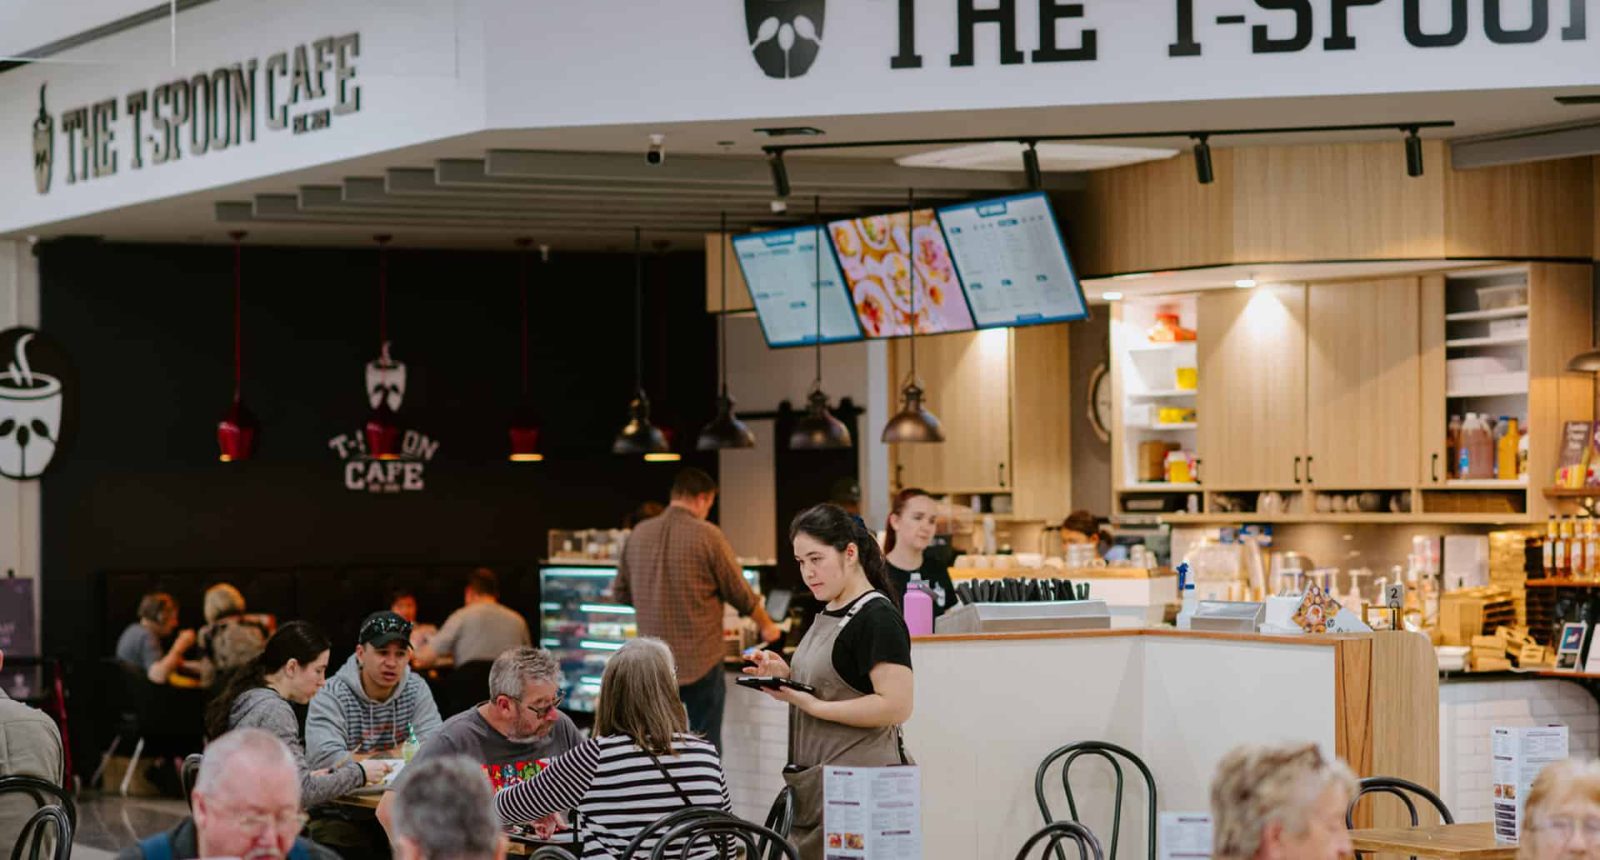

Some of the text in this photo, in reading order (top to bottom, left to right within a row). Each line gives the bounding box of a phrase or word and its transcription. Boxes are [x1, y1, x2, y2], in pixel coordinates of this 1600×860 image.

[1168, 0, 1587, 57] T-SPOO
[61, 31, 361, 185] THE T-SPOON CAFE
[345, 461, 425, 490] CAFE
[1390, 587, 1398, 599] 2
